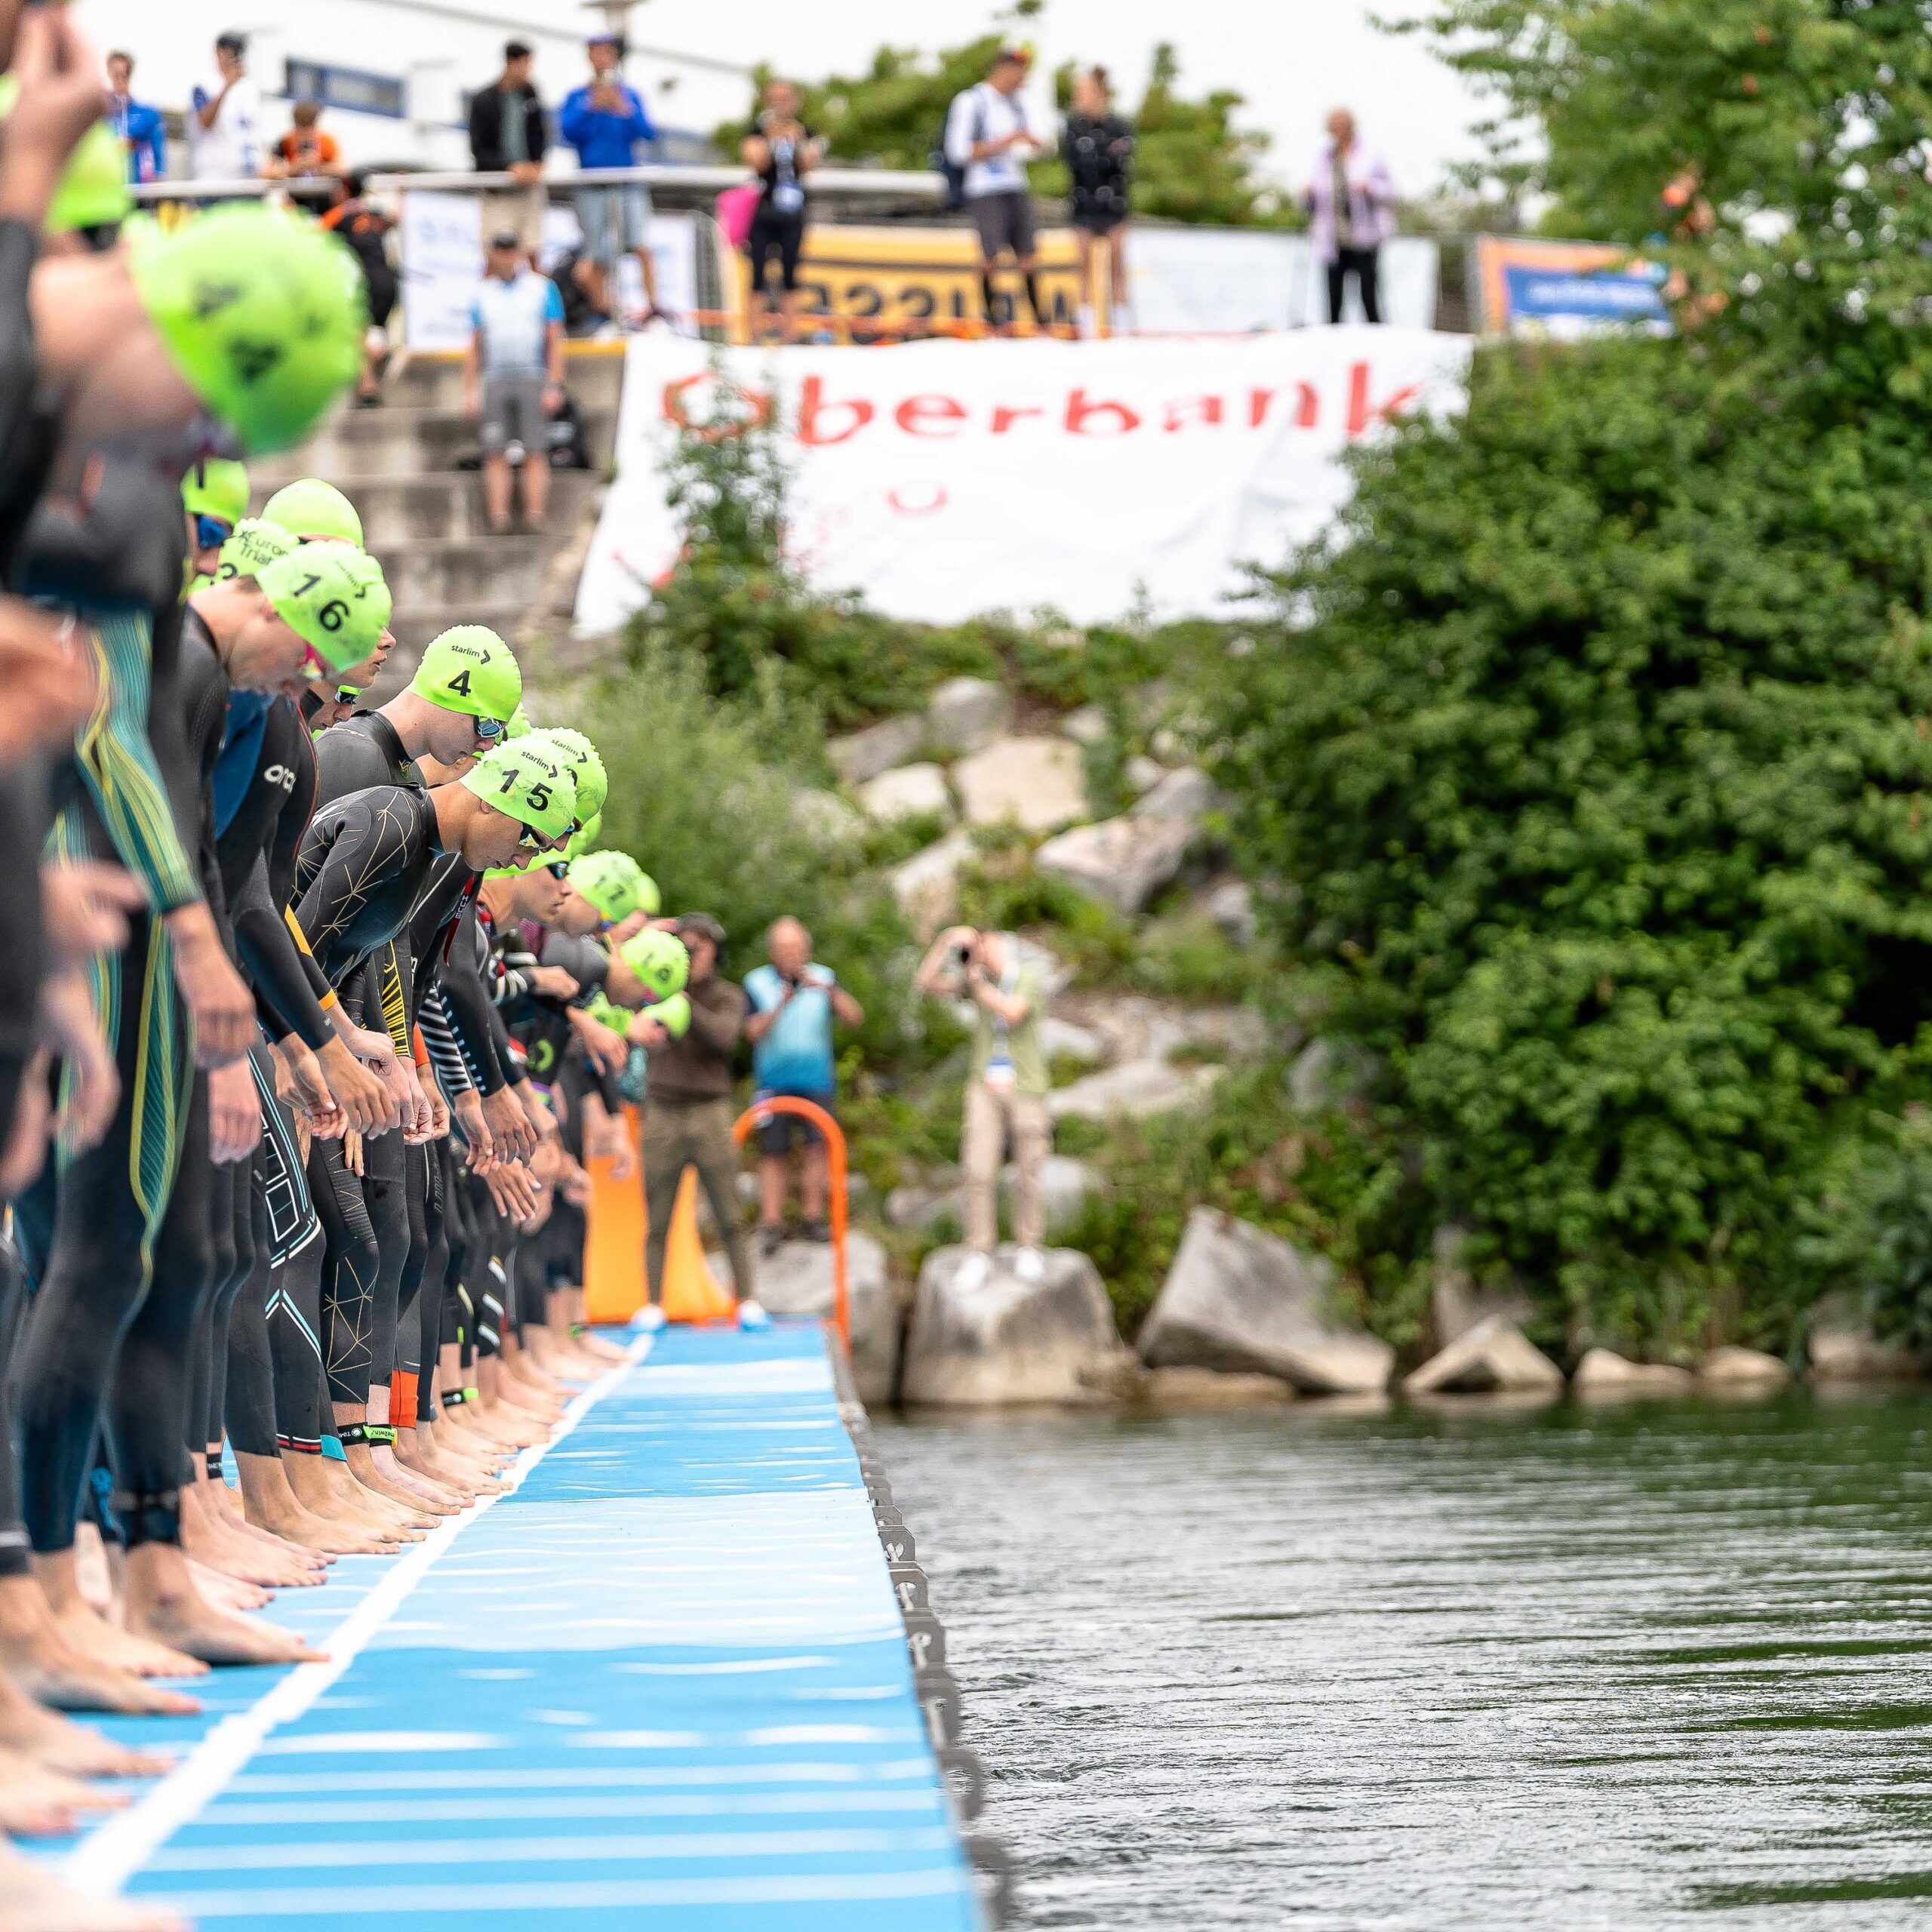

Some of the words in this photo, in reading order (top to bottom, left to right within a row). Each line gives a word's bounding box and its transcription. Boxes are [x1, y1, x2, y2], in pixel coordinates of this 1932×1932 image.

[662, 361, 1423, 447] Oberbank
[241, 542, 272, 565] Triat
[451, 645, 480, 657] starlim
[448, 670, 471, 697] 4
[552, 739, 578, 755] starlim
[521, 751, 549, 770] starlim
